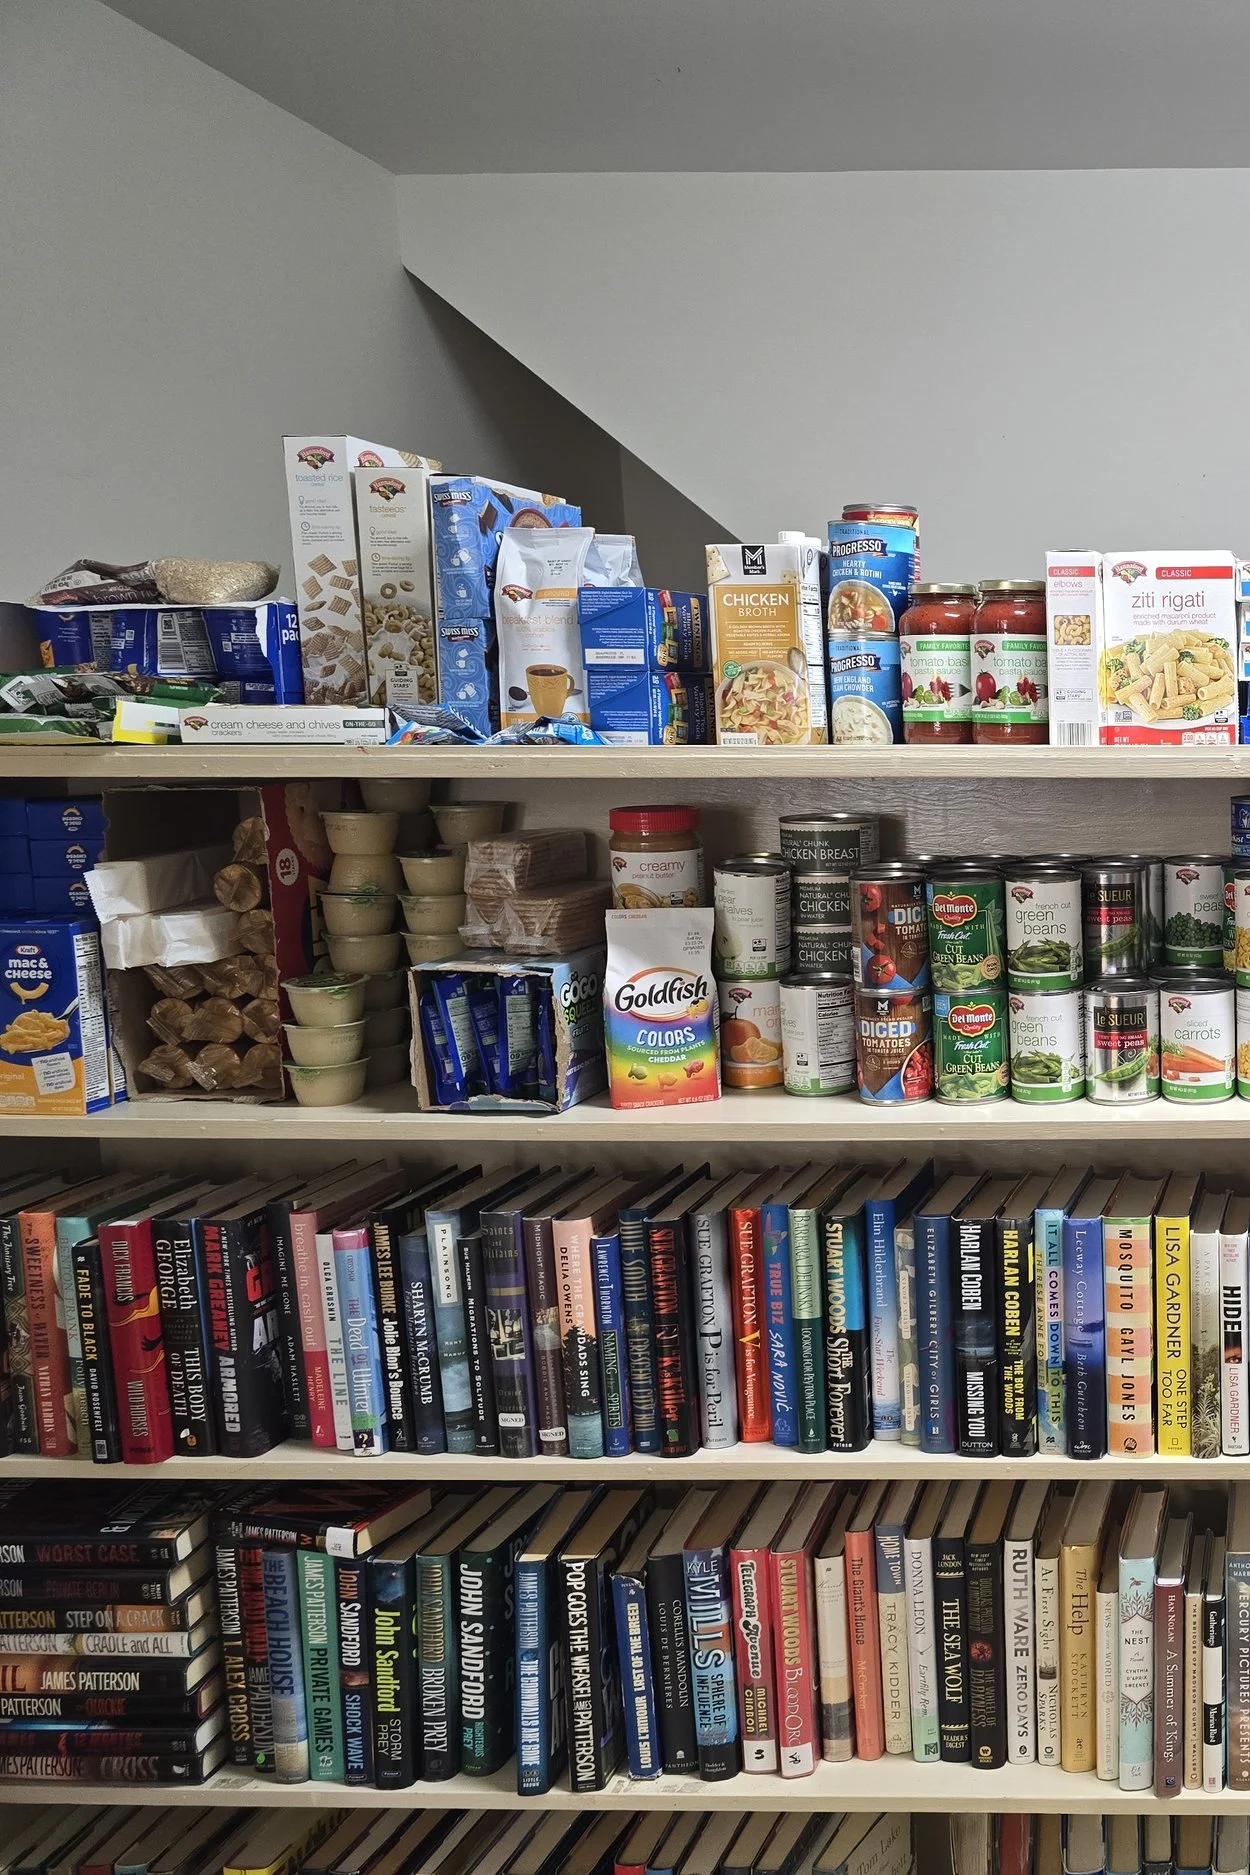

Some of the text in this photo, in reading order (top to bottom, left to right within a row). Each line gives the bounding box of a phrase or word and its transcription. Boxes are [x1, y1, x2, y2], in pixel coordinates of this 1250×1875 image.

[833, 541, 882, 556] PROGRESSO
[1162, 569, 1192, 577] CLASSIC
[1054, 580, 1082, 588] elbows
[723, 593, 789, 606] CHICKEN
[1132, 593, 1205, 611] ziti rigati
[739, 607, 777, 617] BROTH
[1192, 612, 1216, 620] product
[211, 719, 340, 729] cream cheese and chives
[820, 849, 859, 859] BREAST
[640, 862, 685, 872] creamy
[800, 901, 849, 911] CHICKEN
[933, 903, 974, 914] Del Monte
[1016, 909, 1054, 923] green
[1024, 922, 1067, 935] beans
[799, 950, 847, 961] CHICKEN
[945, 945, 963, 953] CUT
[933, 953, 984, 964] GREEN BEANS
[615, 976, 707, 1012] Goldfish
[1108, 1011, 1144, 1026] SUEUR
[861, 1021, 912, 1037] DICED
[1174, 1027, 1221, 1040] carrots
[636, 1027, 696, 1047] COLORS
[862, 1038, 911, 1047] TOMATOES
[1017, 1034, 1057, 1046] beans
[648, 1055, 687, 1063] CHEDDAR
[441, 1229, 451, 1299] PLAINSONG
[826, 1224, 846, 1334] STUART WOODS
[1165, 1228, 1181, 1359] LISA GARDNER
[77, 1270, 97, 1360] FADE TO BLACK
[1223, 1286, 1241, 1331] HIDE
[696, 1220, 723, 1428] SUE GRAFTON P is for Peril
[960, 1225, 984, 1437] HARLAN COBEN MISSING YOU
[1118, 1230, 1134, 1421] MOSQUITO GAYL JONES
[410, 1282, 432, 1404] SHARYN McCRUMB
[769, 1264, 790, 1412] TRUE BIZ SARA NOVIĆ
[218, 1356, 240, 1432] ARMORED
[1162, 1370, 1172, 1426] TOO FAR
[1176, 1370, 1187, 1428] ONE STEP
[688, 1561, 718, 1573] KYLE
[1012, 1549, 1028, 1657] RUTH WARE
[340, 1568, 362, 1666] JOHN SANDFORD
[690, 1576, 724, 1667] MILLS
[1124, 1637, 1149, 1645] NEST
[942, 1599, 962, 1703] THE SEA WOLF
[375, 1609, 400, 1711] John Sandford
